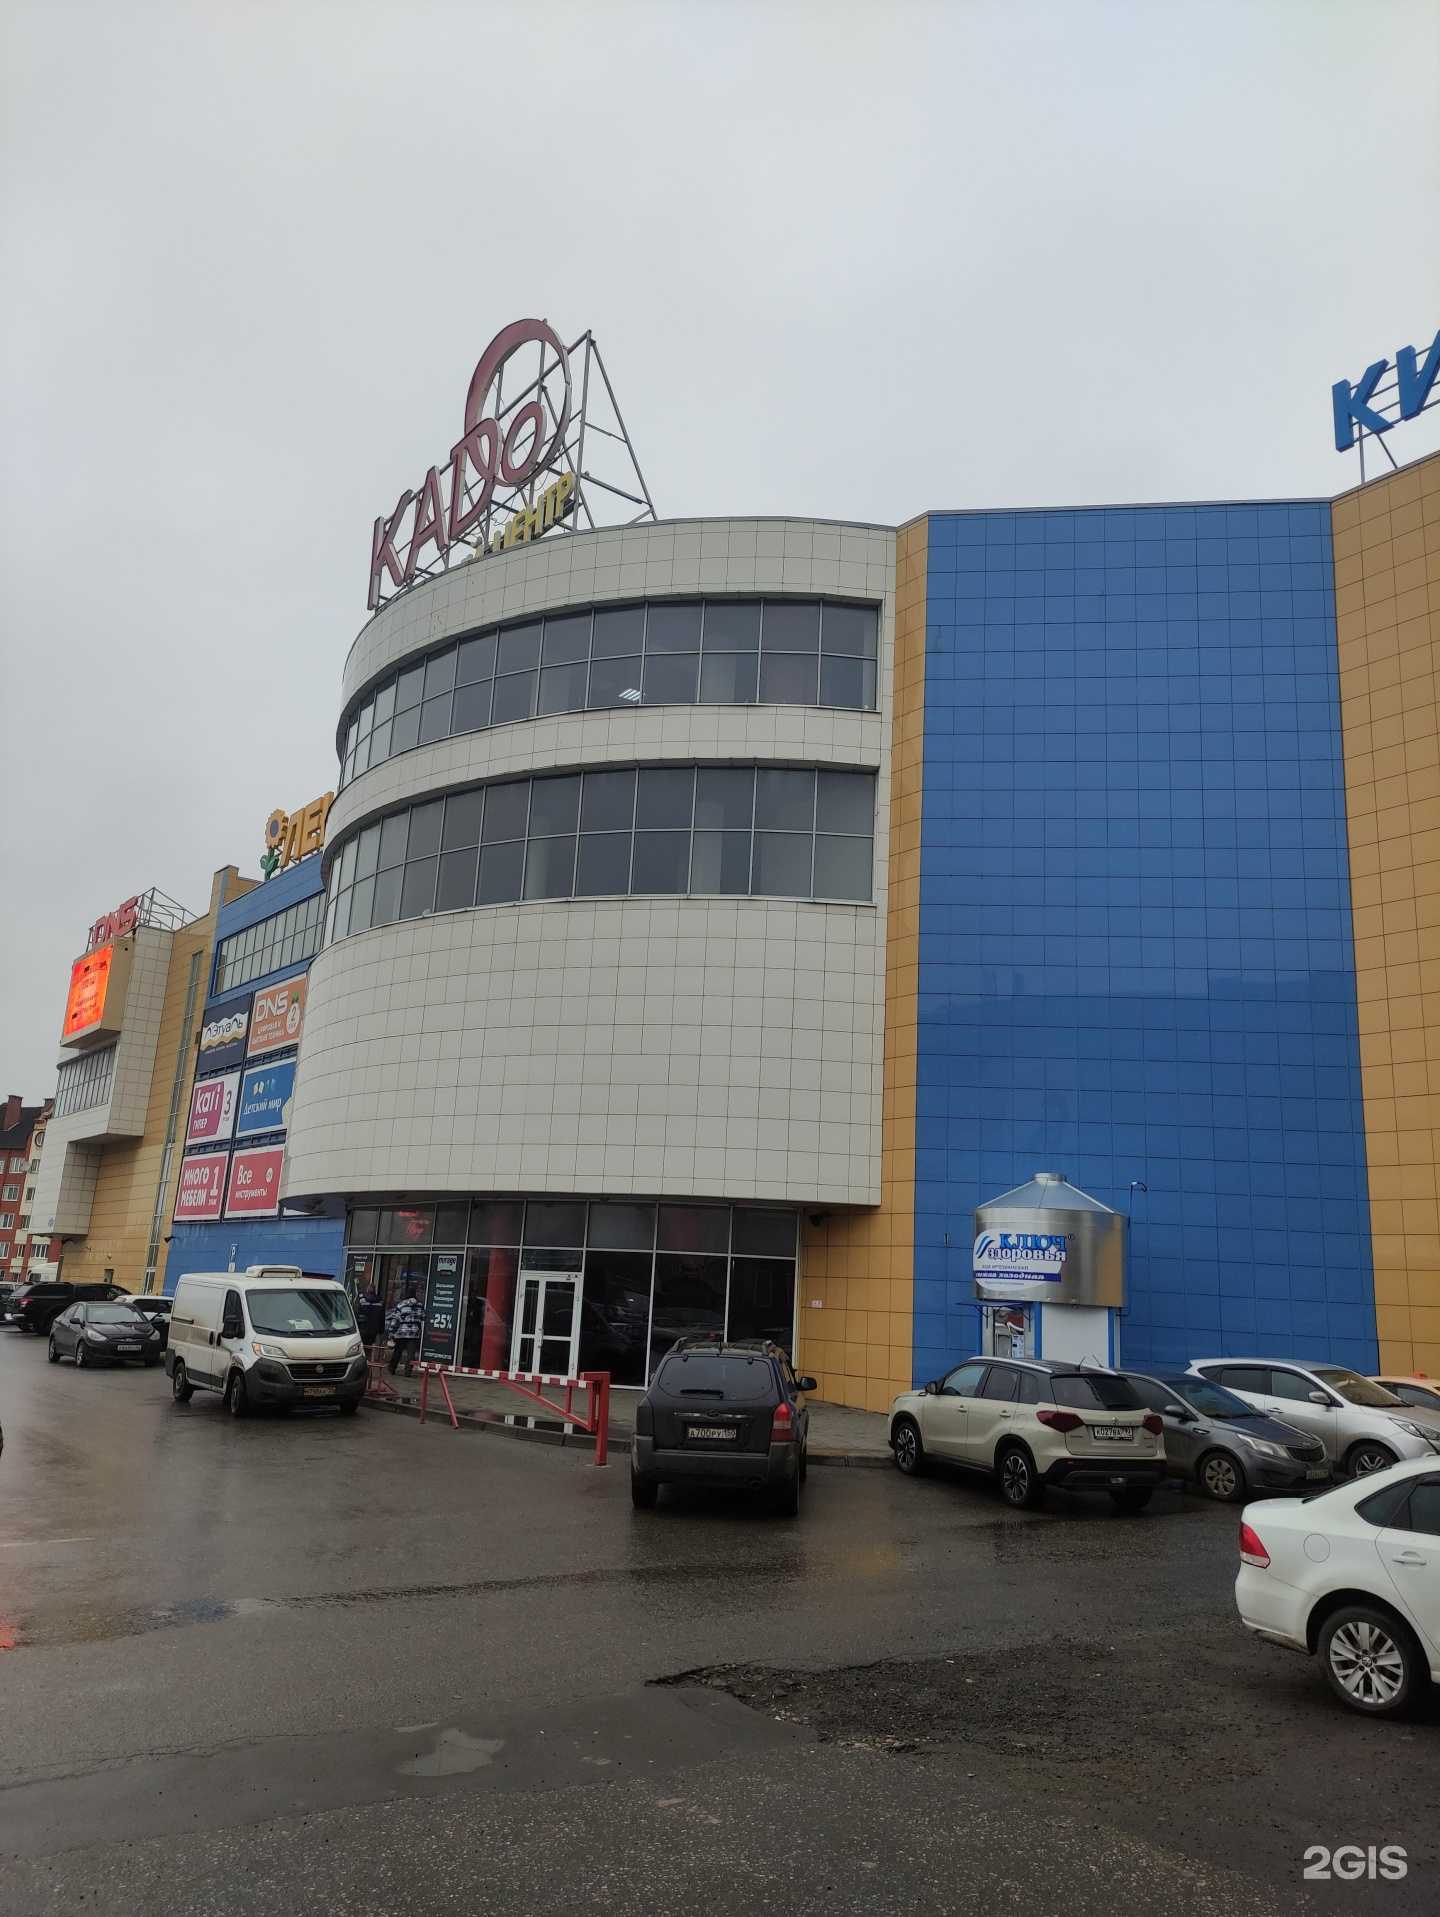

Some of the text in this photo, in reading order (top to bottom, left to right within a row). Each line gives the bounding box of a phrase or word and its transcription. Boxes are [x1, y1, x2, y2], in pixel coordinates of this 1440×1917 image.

[255, 991, 288, 1022] DNS
[195, 1084, 221, 1115] kari
[224, 1090, 232, 1115] 3
[243, 1098, 282, 1115] Детский мир
[183, 1166, 210, 1186] МНОГО
[210, 1165, 220, 1196] 1
[237, 1164, 253, 1185] Все
[181, 1188, 207, 1207] МЕБЕЛИ
[999, 1233, 1066, 1250] КЛЮЧ
[430, 1314, 452, 1329] -25%
